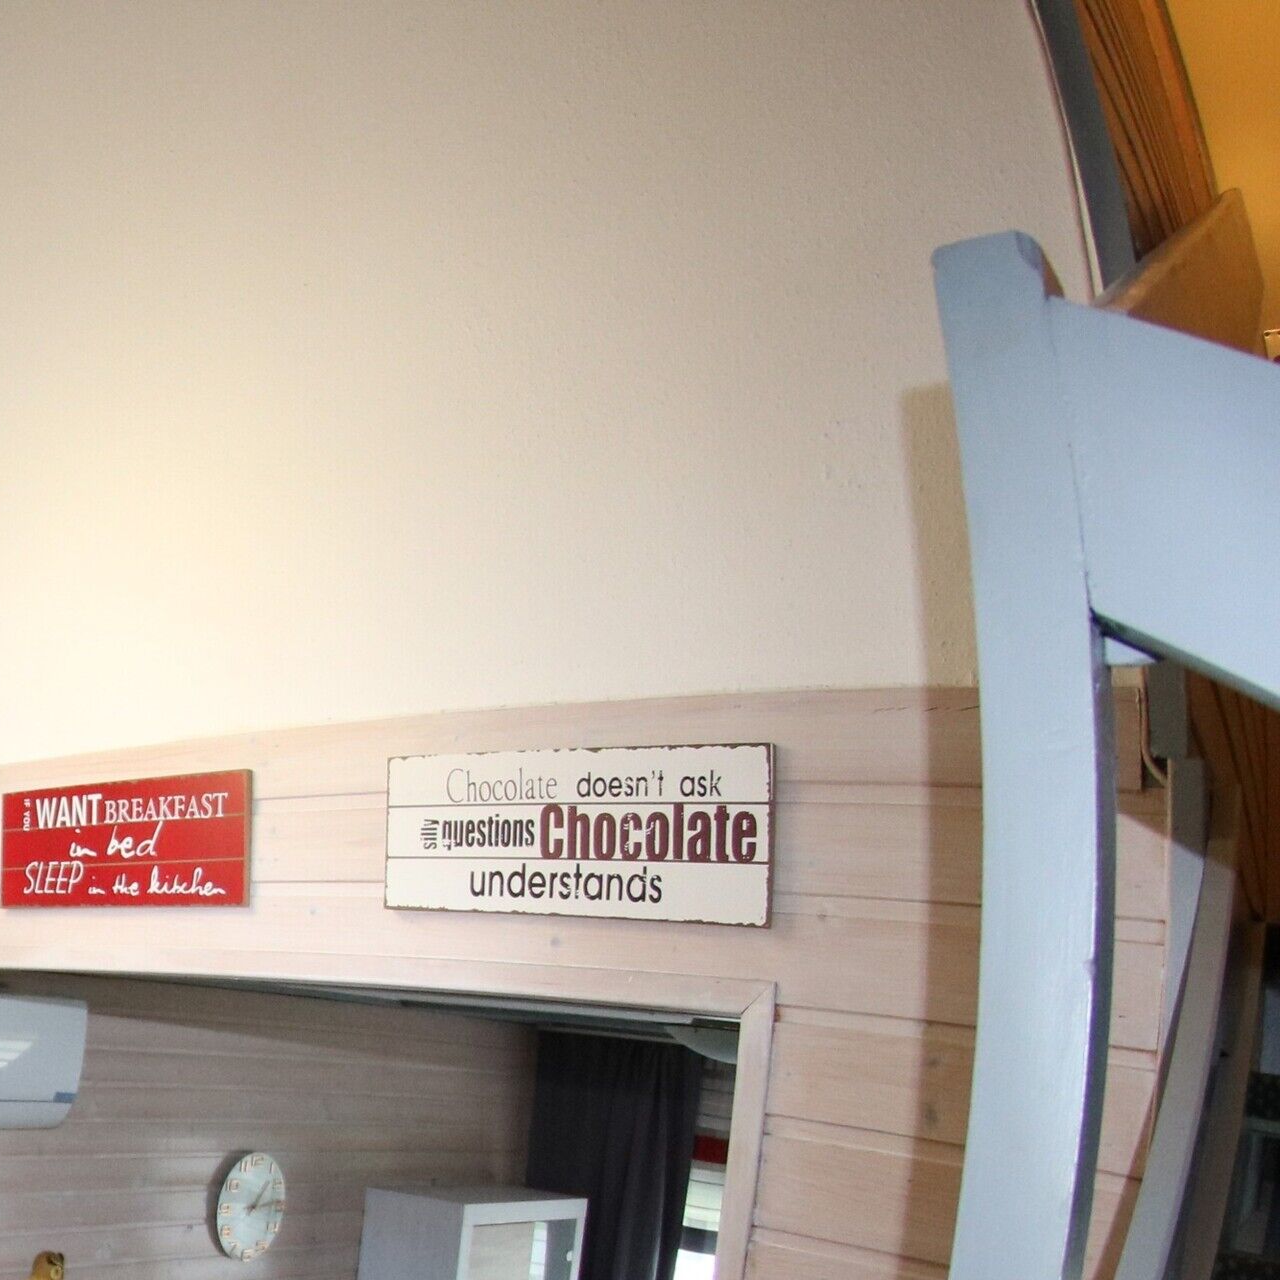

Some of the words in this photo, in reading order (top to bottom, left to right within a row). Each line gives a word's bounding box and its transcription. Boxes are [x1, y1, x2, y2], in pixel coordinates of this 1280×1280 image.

[446, 767, 558, 803] Chocolate
[577, 770, 664, 798] doesn't
[679, 769, 722, 798] ask
[22, 811, 31, 832] YOU
[23, 799, 31, 808] IF
[35, 793, 102, 829] WANT
[103, 792, 228, 824] BREAKFAST
[69, 828, 98, 858] in
[106, 820, 163, 859] bed
[420, 819, 439, 850] silly
[442, 813, 535, 851] questions
[539, 802, 758, 864] Chocolate
[23, 860, 84, 894] SLEEP
[87, 875, 106, 895] in
[112, 873, 140, 896] the
[146, 865, 226, 896] kitchen
[469, 862, 663, 903] understands
